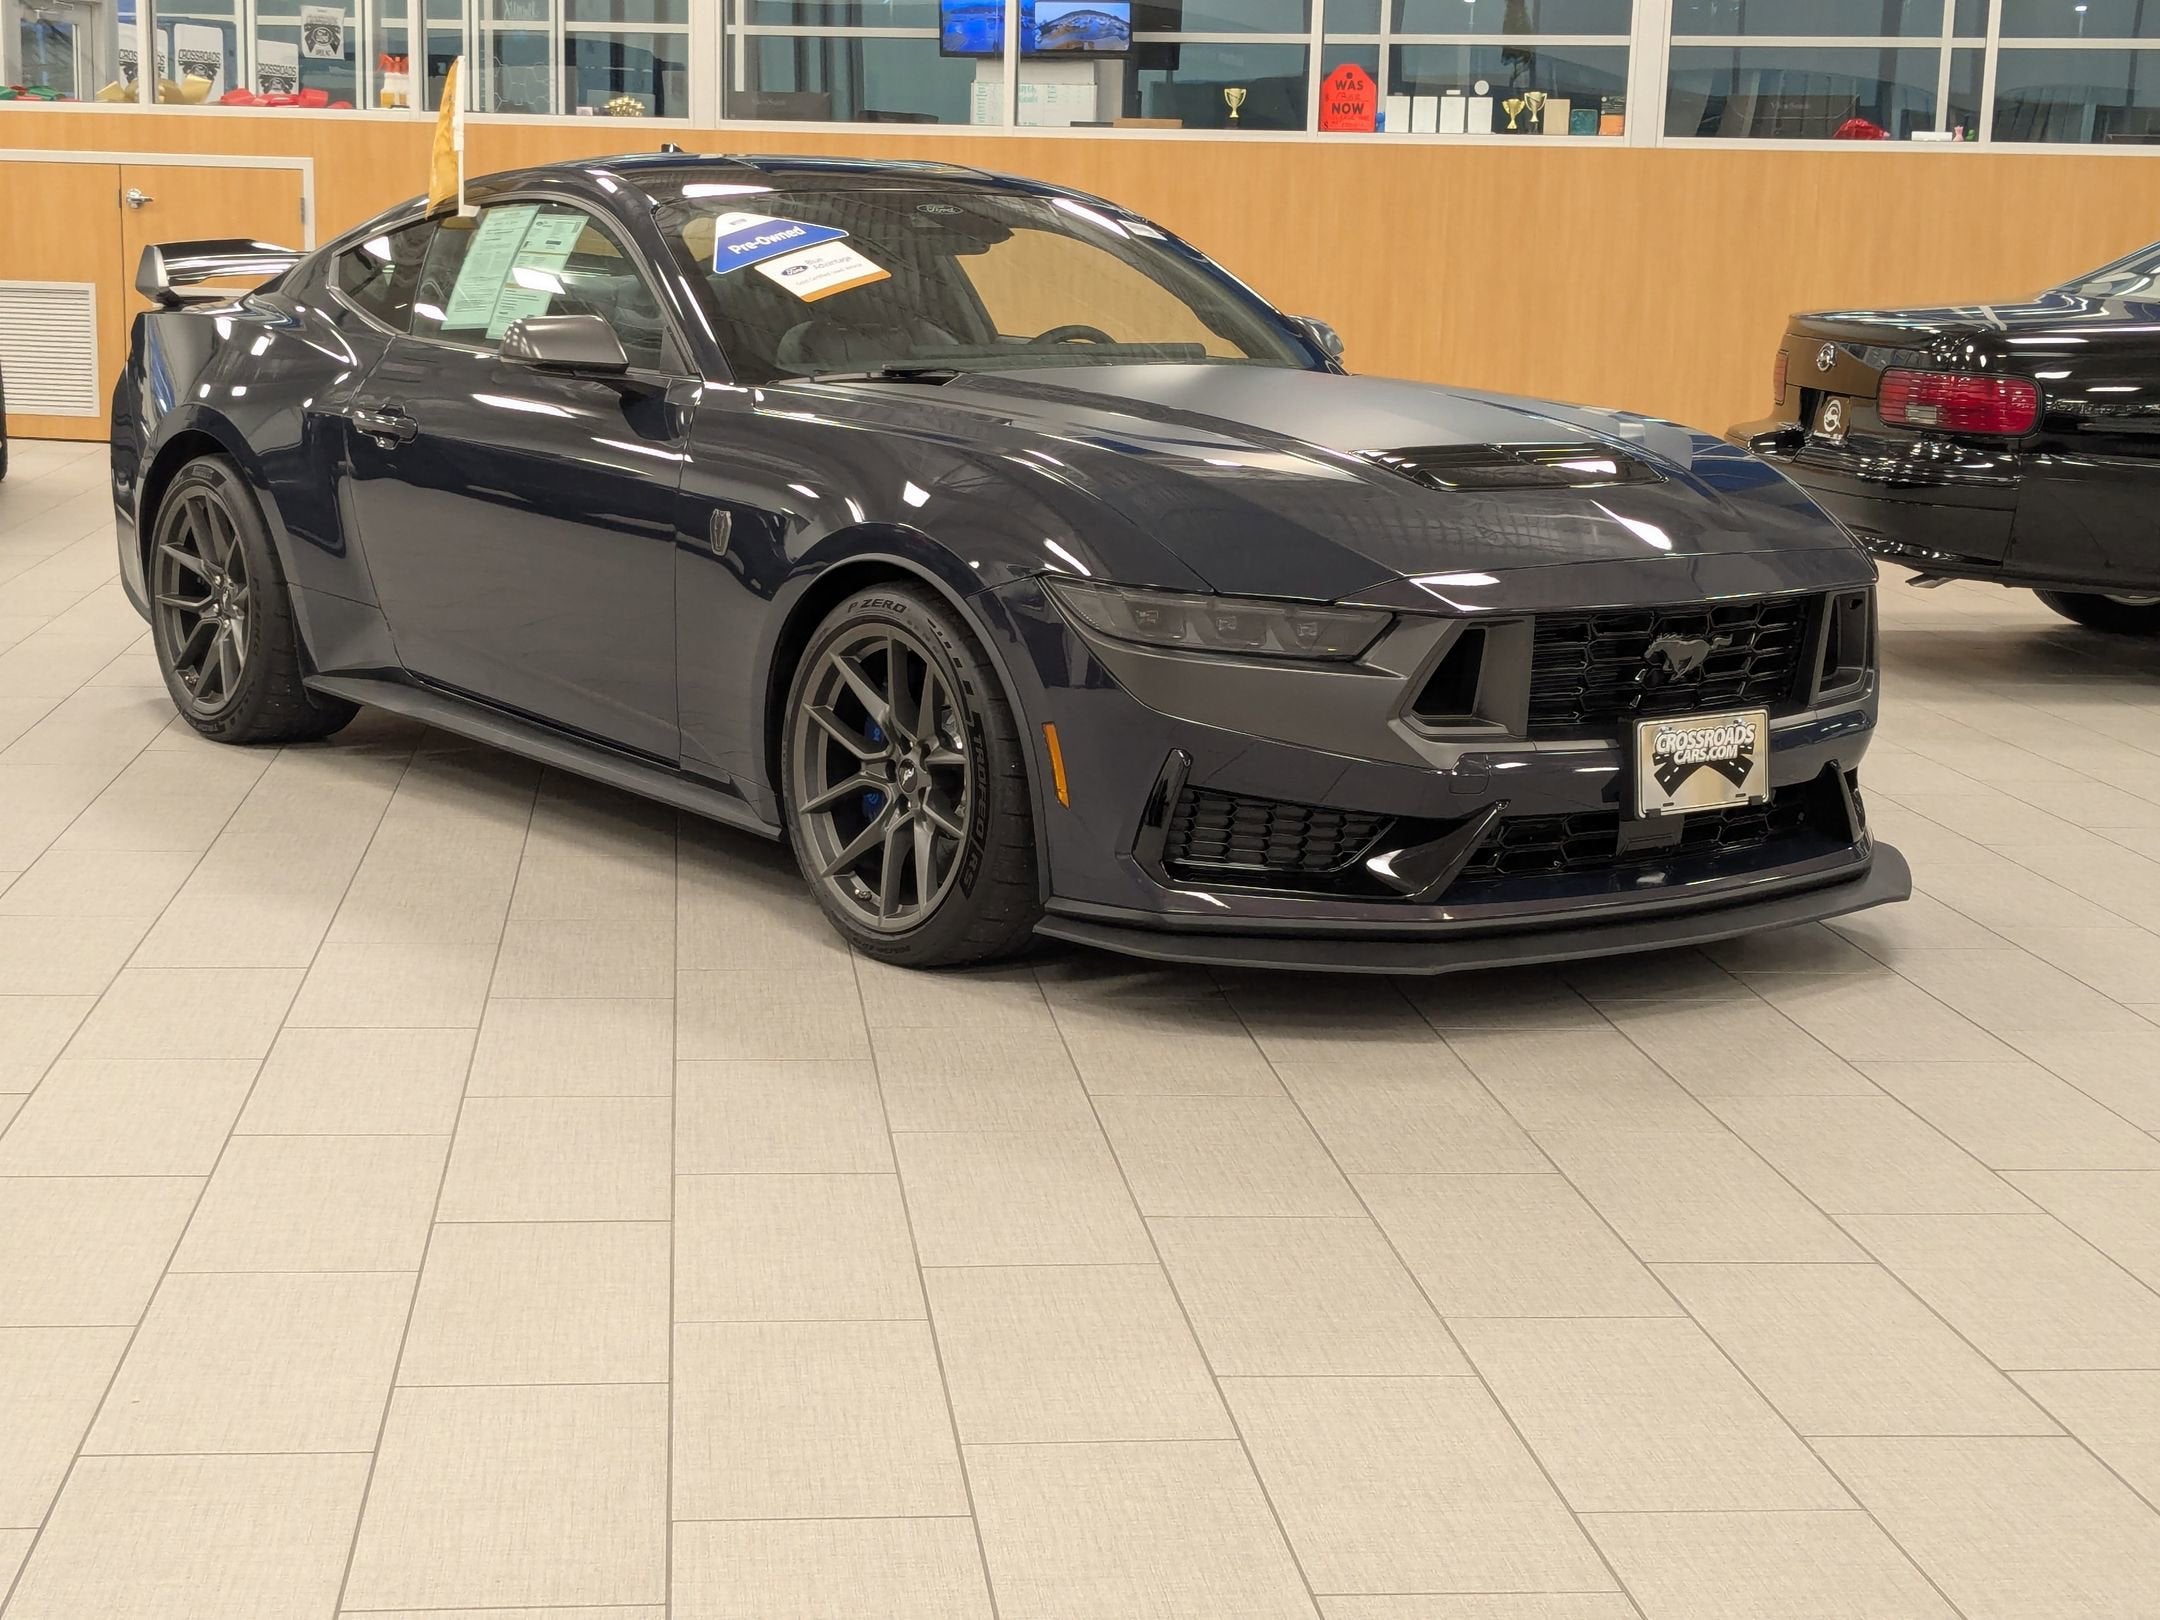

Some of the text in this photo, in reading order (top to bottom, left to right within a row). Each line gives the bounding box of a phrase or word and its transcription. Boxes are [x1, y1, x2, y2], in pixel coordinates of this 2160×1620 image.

[178, 48, 221, 63] CROSSROADS
[1335, 80, 1364, 90] WAS
[1331, 102, 1364, 114] NOW
[727, 226, 807, 254] Pre-Owned
[847, 598, 907, 614] P ZERO
[1655, 724, 1757, 755] CROSSROADS
[1673, 744, 1739, 765] CARS.COM
[963, 735, 988, 889] TROFEO RS
